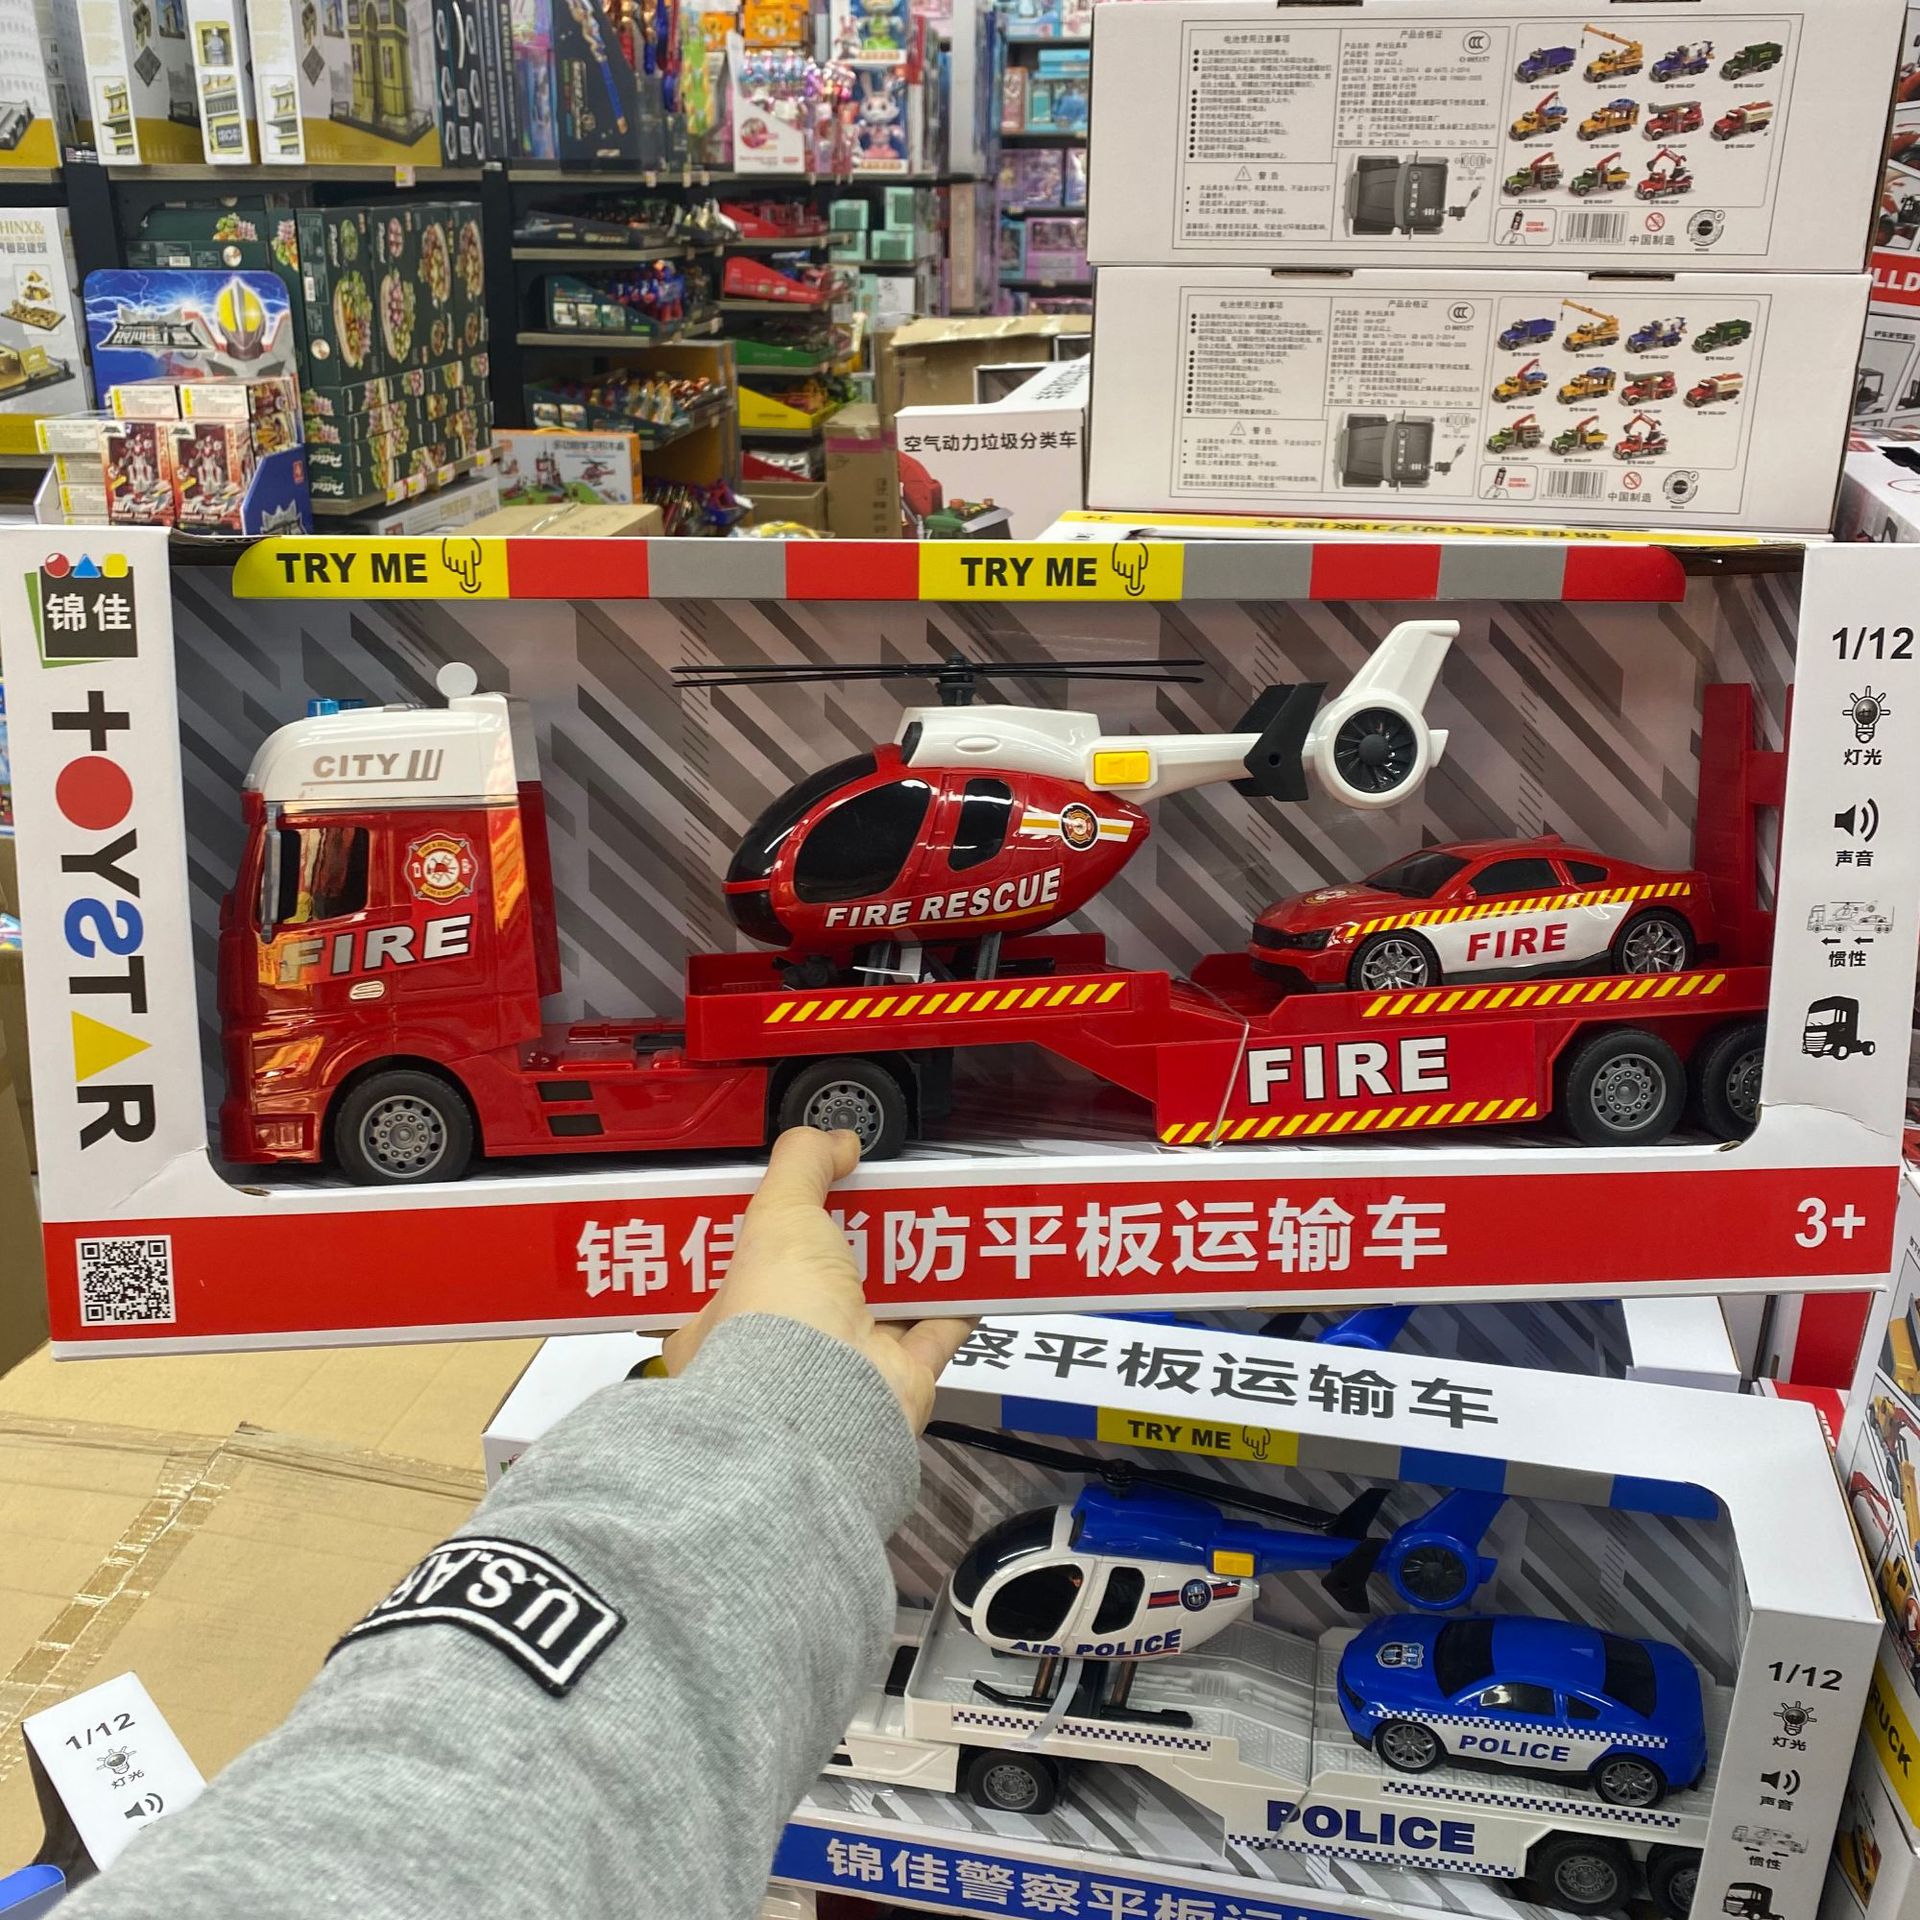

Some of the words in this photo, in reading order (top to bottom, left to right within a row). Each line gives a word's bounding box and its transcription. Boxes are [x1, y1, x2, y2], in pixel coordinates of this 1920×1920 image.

[1628, 234, 1675, 246] 中国制造
[903, 430, 1078, 453] 空气动力垃圾分类车
[1607, 492, 1651, 503] 中国制造
[276, 553, 357, 583] TRY
[371, 553, 428, 583] ME
[960, 557, 1034, 586] TRY
[1046, 557, 1097, 586] ME
[46, 593, 132, 632] 锦佳
[1832, 627, 1914, 660] 1/12
[312, 753, 400, 778] CITY
[1843, 748, 1882, 766] 灯光
[1835, 850, 1874, 867] 声音
[825, 901, 911, 927] FIRE
[919, 866, 1061, 921] RESCUE
[275, 914, 472, 985] FIRE
[1466, 923, 1569, 962] FIRE
[1828, 950, 1867, 968] 惯性
[1247, 1035, 1449, 1105] FIRE
[1794, 1197, 1866, 1248] 3+
[1127, 1419, 1180, 1444] TRY
[1192, 1427, 1232, 1451] ME
[1011, 1640, 1061, 1655] AIR
[1075, 1628, 1182, 1656] POLICE
[1768, 1662, 1843, 1691] 1/12
[65, 1713, 136, 1749] 1/12
[1772, 1736, 1807, 1751] 灯光
[1458, 1734, 1571, 1762] POLICE
[111, 1769, 145, 1790] 灯光
[1760, 1796, 1793, 1811] 声音
[1267, 1800, 1475, 1855] POLICE
[1749, 1855, 1782, 1871] 惯性
